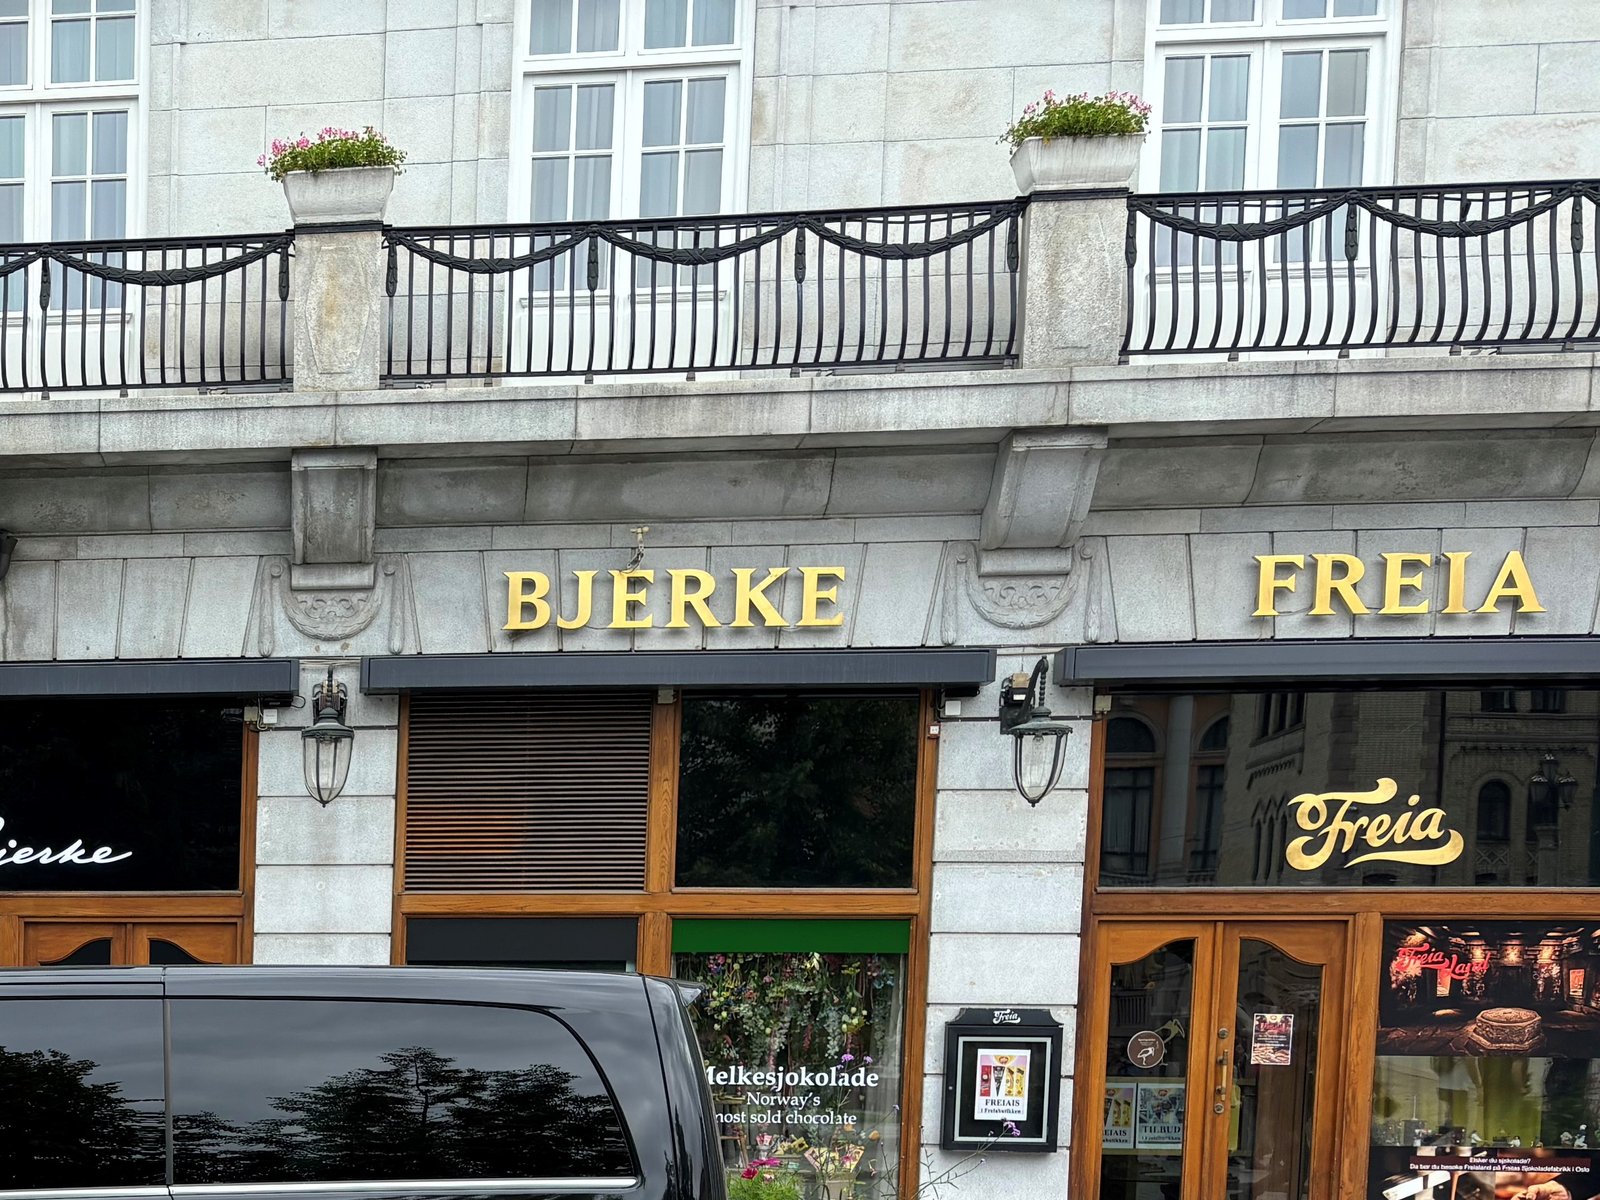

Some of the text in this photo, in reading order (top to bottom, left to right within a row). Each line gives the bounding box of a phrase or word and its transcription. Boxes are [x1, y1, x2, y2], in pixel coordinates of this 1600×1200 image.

[1251, 551, 1547, 616] FREIA
[502, 566, 846, 630] BJERKE
[1286, 777, 1464, 871] Freia
[1395, 943, 1450, 972] Freia
[993, 1009, 1021, 1025] Freia
[985, 1099, 1020, 1107] FREIAIS
[750, 1111, 781, 1124] sold
[785, 1111, 858, 1125] chocolate
[1103, 1129, 1127, 1137] EIAIS
[1143, 1125, 1181, 1134] TILBUD
